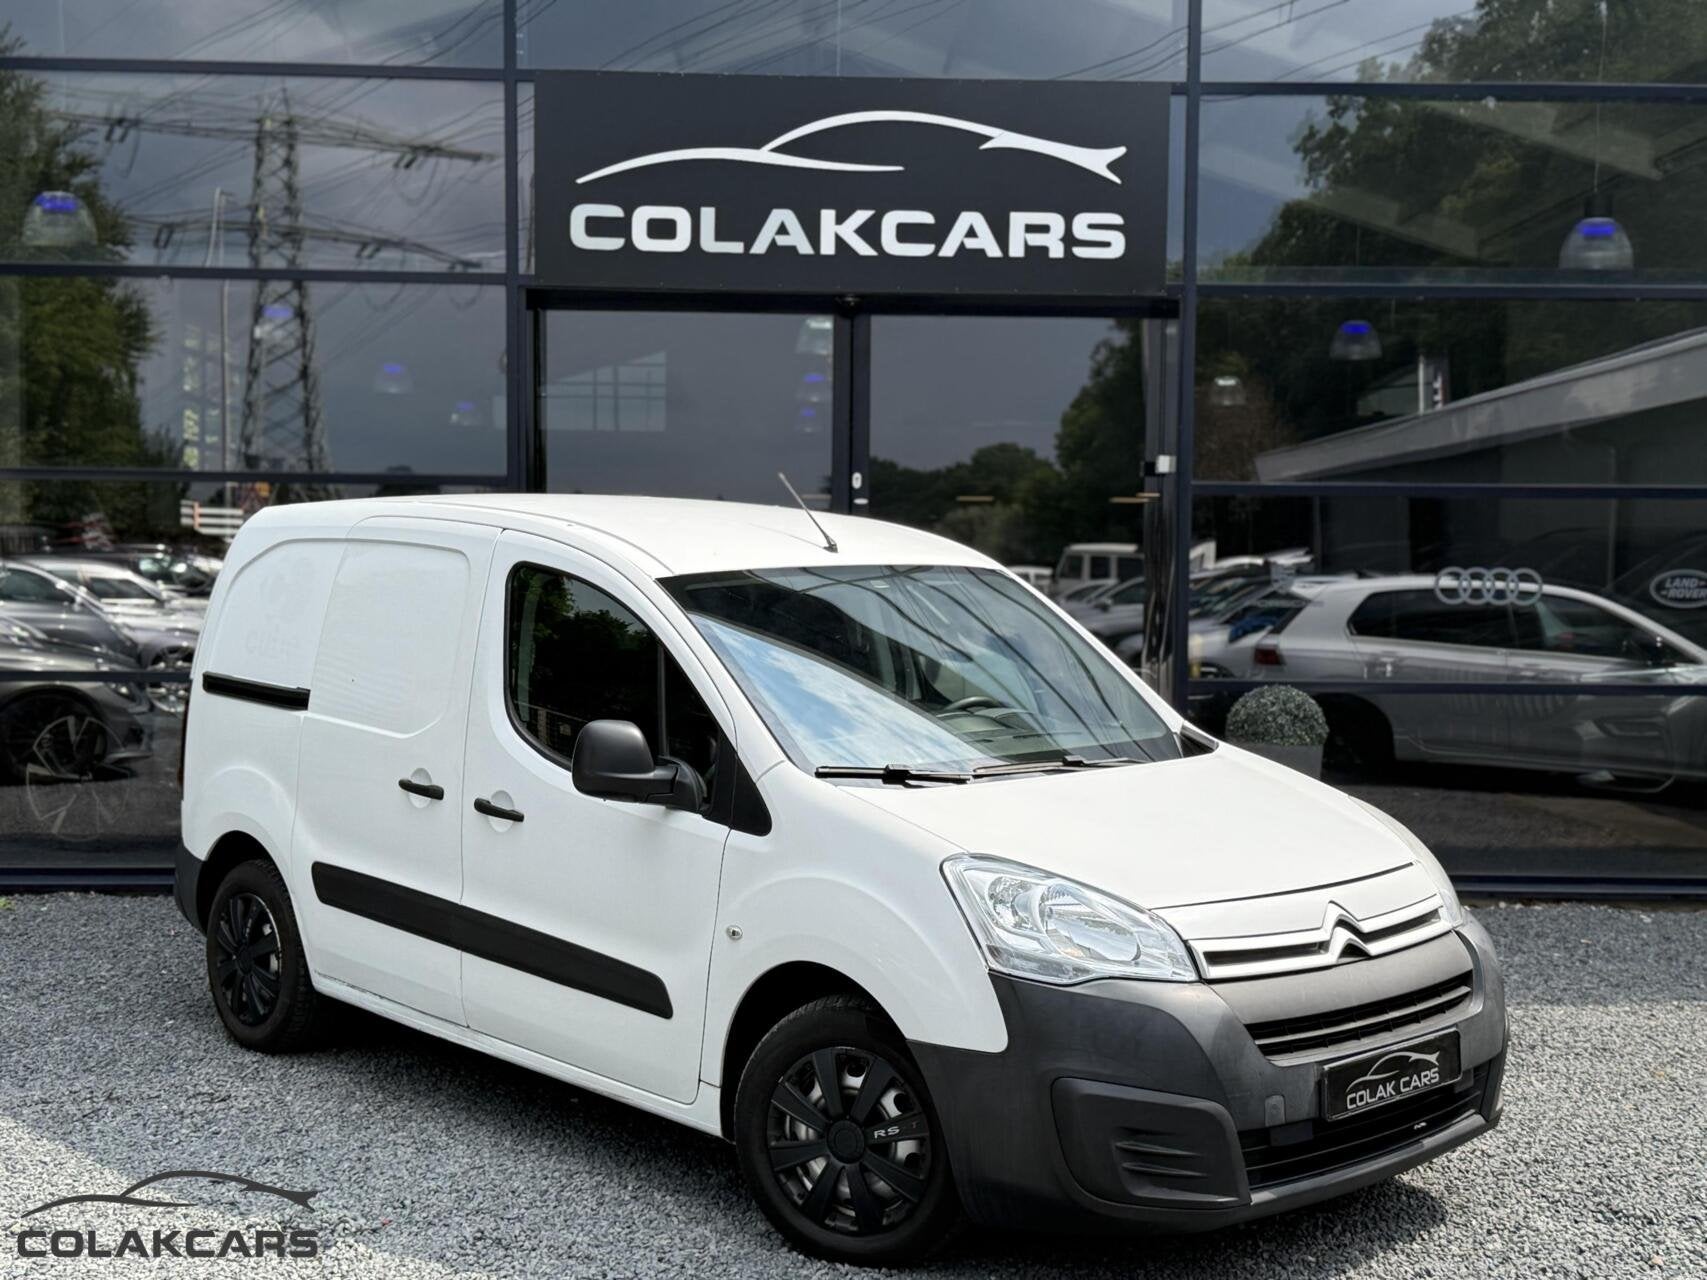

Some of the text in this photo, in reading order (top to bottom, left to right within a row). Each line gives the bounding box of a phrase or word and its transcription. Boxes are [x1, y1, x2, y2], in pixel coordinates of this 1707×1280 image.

[569, 203, 1126, 259] COLAKCARS
[1346, 1067, 1440, 1110] COLAK CARS
[873, 1126, 900, 1139] RS
